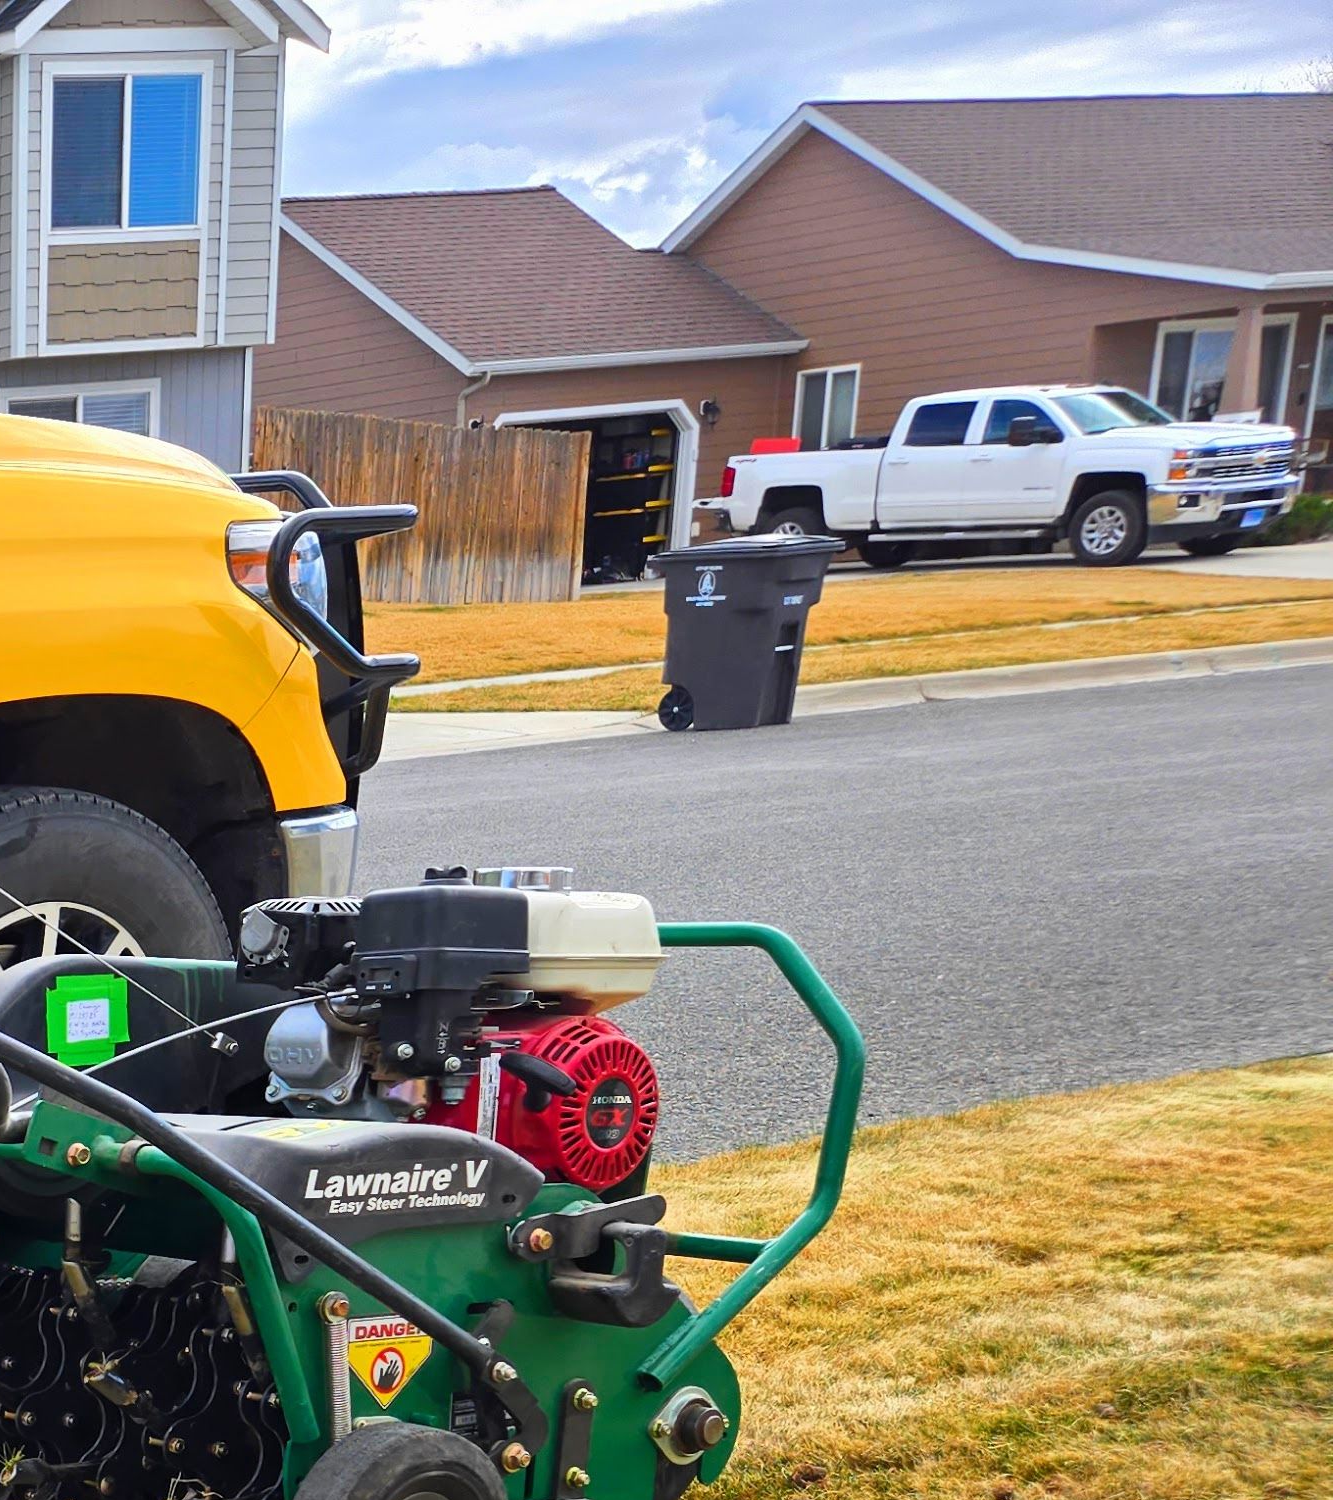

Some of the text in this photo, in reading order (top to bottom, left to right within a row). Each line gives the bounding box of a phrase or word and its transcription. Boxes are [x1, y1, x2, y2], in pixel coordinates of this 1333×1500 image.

[591, 1095, 632, 1105] HONDA
[590, 1107, 629, 1127] GX
[465, 1159, 489, 1189] V
[328, 1191, 486, 1216] Easy Steer Technology
[355, 1321, 421, 1340] DANGE
